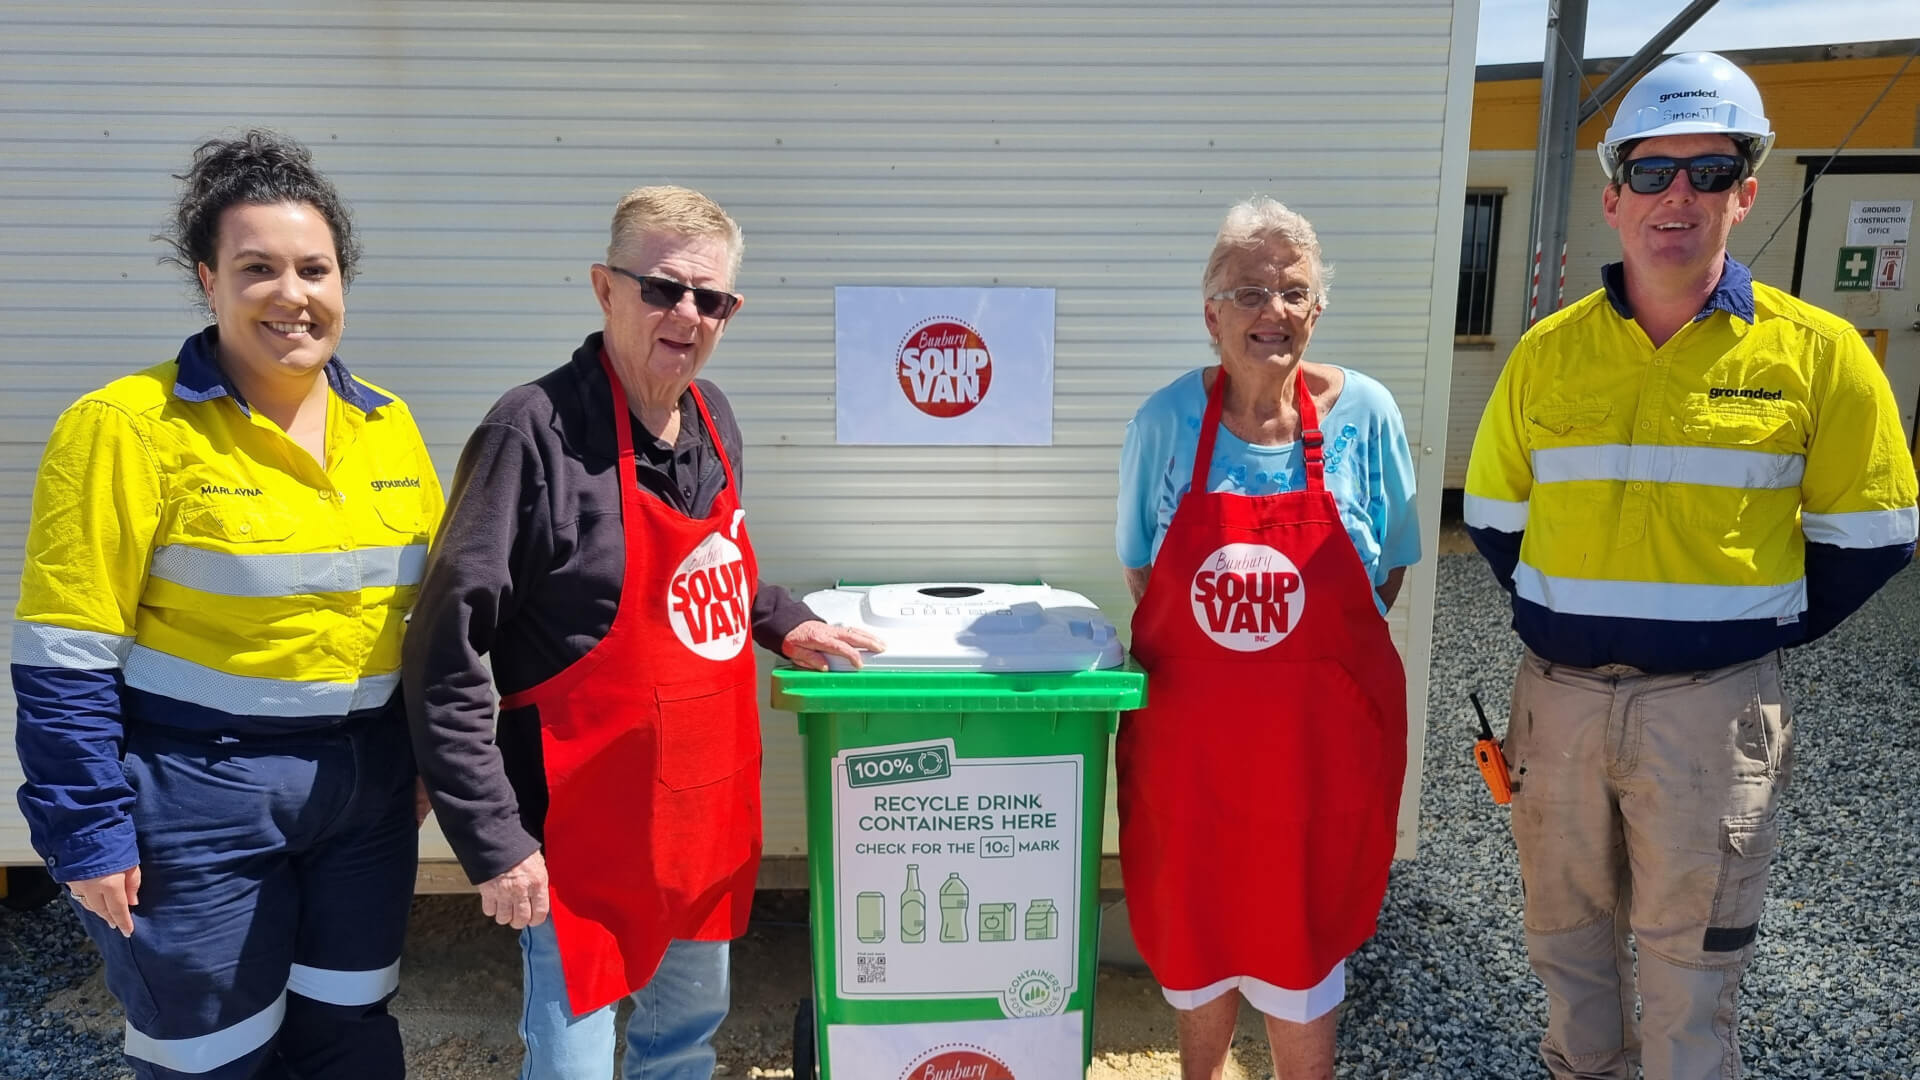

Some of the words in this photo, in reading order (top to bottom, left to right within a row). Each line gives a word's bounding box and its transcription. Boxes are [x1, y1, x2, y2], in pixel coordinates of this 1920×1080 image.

[1861, 206, 1902, 214] GROUNDED
[1853, 216, 1907, 225] CONSTRUCTION
[1867, 227, 1890, 235] OFFICE
[1838, 280, 1857, 288] FIRST
[919, 329, 968, 349] Bunbury
[902, 347, 988, 376] SOUP
[909, 374, 980, 403] VAN
[200, 485, 264, 497] MARLAYNA
[1215, 551, 1273, 572] Bunbury
[1195, 571, 1300, 603] SOUP
[682, 597, 746, 644] VAN
[1203, 601, 1289, 634] VAN
[855, 757, 915, 779] 100%
[874, 795, 969, 812] RECYCLE
[977, 793, 1043, 811] DRINK
[858, 814, 994, 832] CONTAINERS
[1002, 812, 1057, 830] HERE
[855, 842, 907, 855] CHECK
[912, 842, 942, 855] FOR
[947, 842, 976, 855] THE
[984, 840, 1011, 855] 10c
[1018, 839, 1060, 852] MARK
[1008, 968, 1061, 995] CONTAINERS
[1010, 997, 1024, 1015] FOR
[1024, 996, 1060, 1018] CHANGE
[922, 1060, 989, 1080] Bunbury
